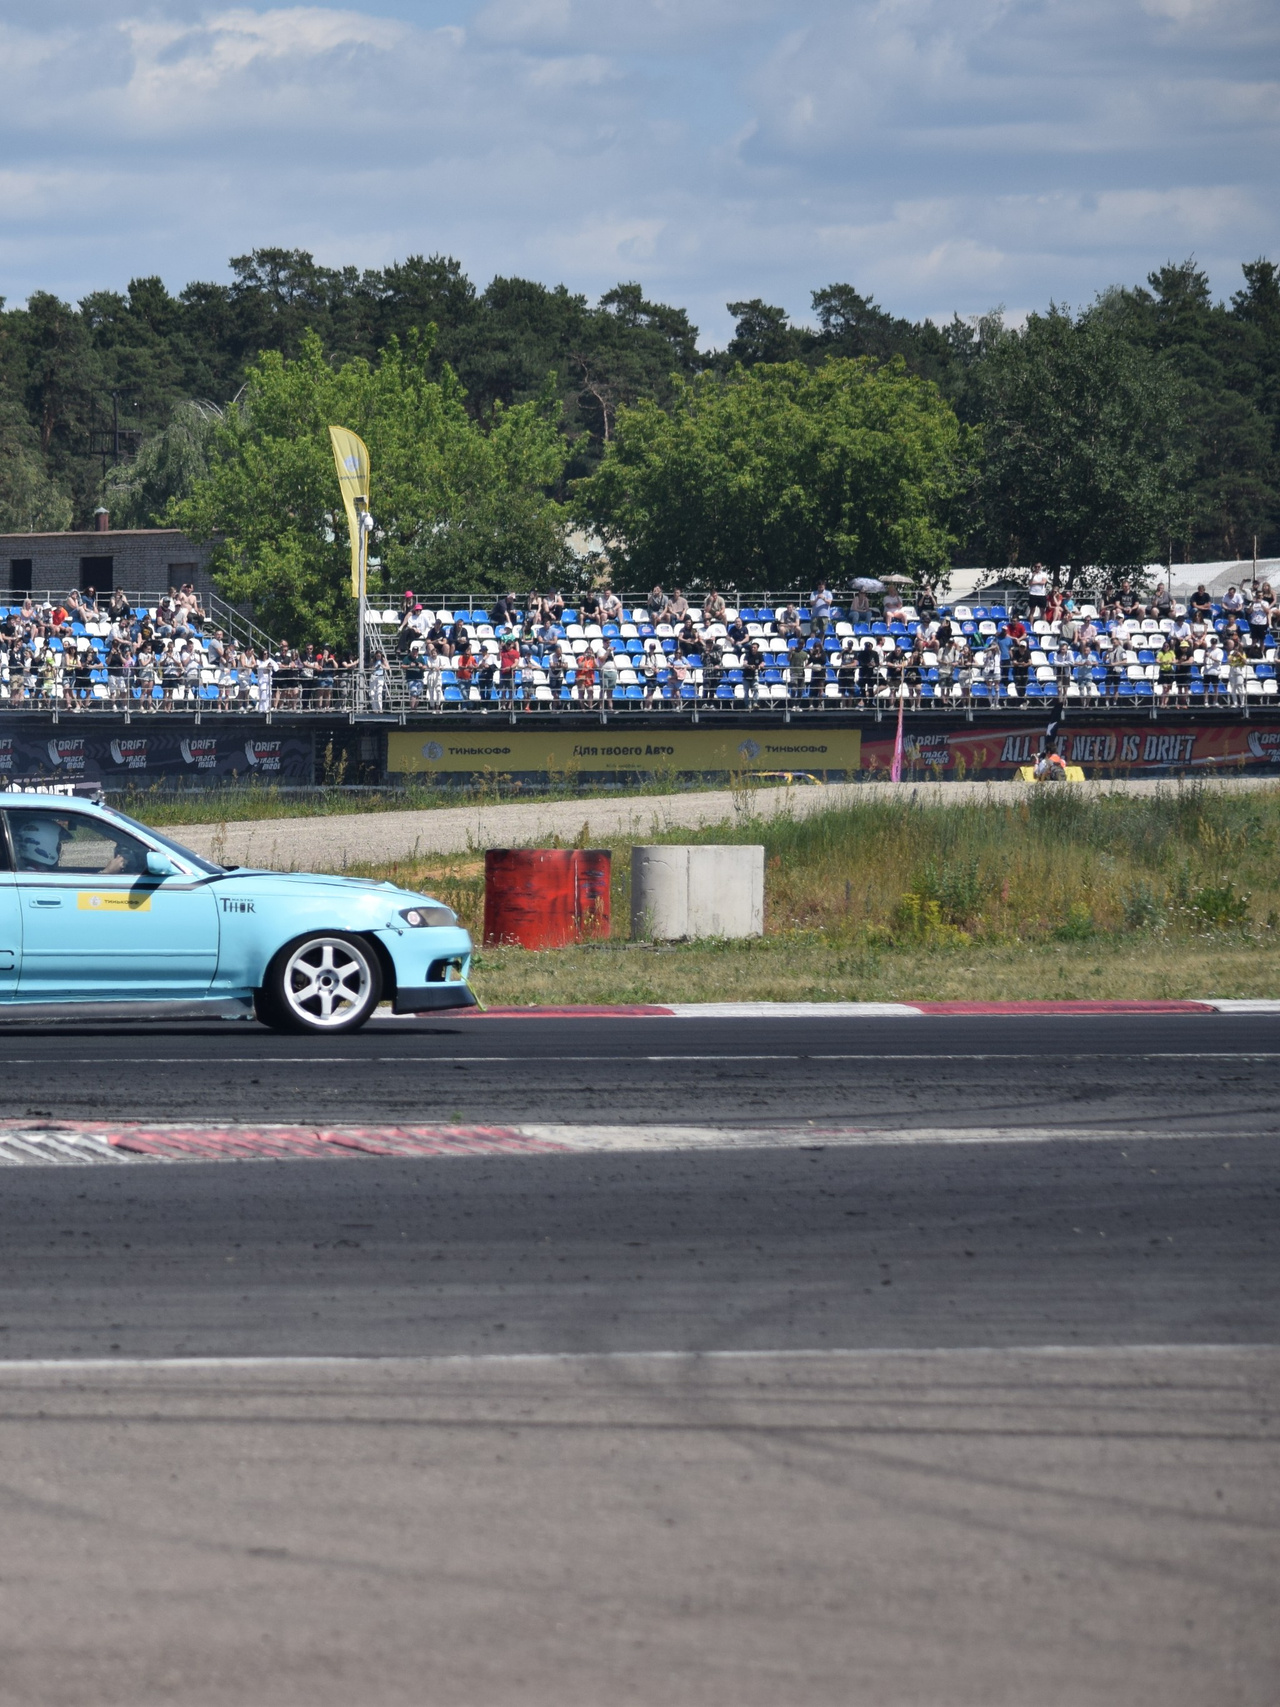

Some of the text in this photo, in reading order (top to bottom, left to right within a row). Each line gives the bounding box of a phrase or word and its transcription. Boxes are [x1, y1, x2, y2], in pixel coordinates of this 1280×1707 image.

[58, 739, 84, 750] DRIFT
[121, 739, 147, 750] DRIFT
[191, 739, 217, 750] DRIFT
[254, 741, 281, 751] DRIFT
[917, 735, 949, 746] DRIFT
[448, 747, 511, 755] ТИНЬКОФФ
[573, 745, 674, 758] Для твоего Авто
[1001, 736, 1031, 761] ALL
[1072, 736, 1116, 761] NEED
[1122, 736, 1140, 761] IS
[1144, 736, 1196, 761] DRIFT
